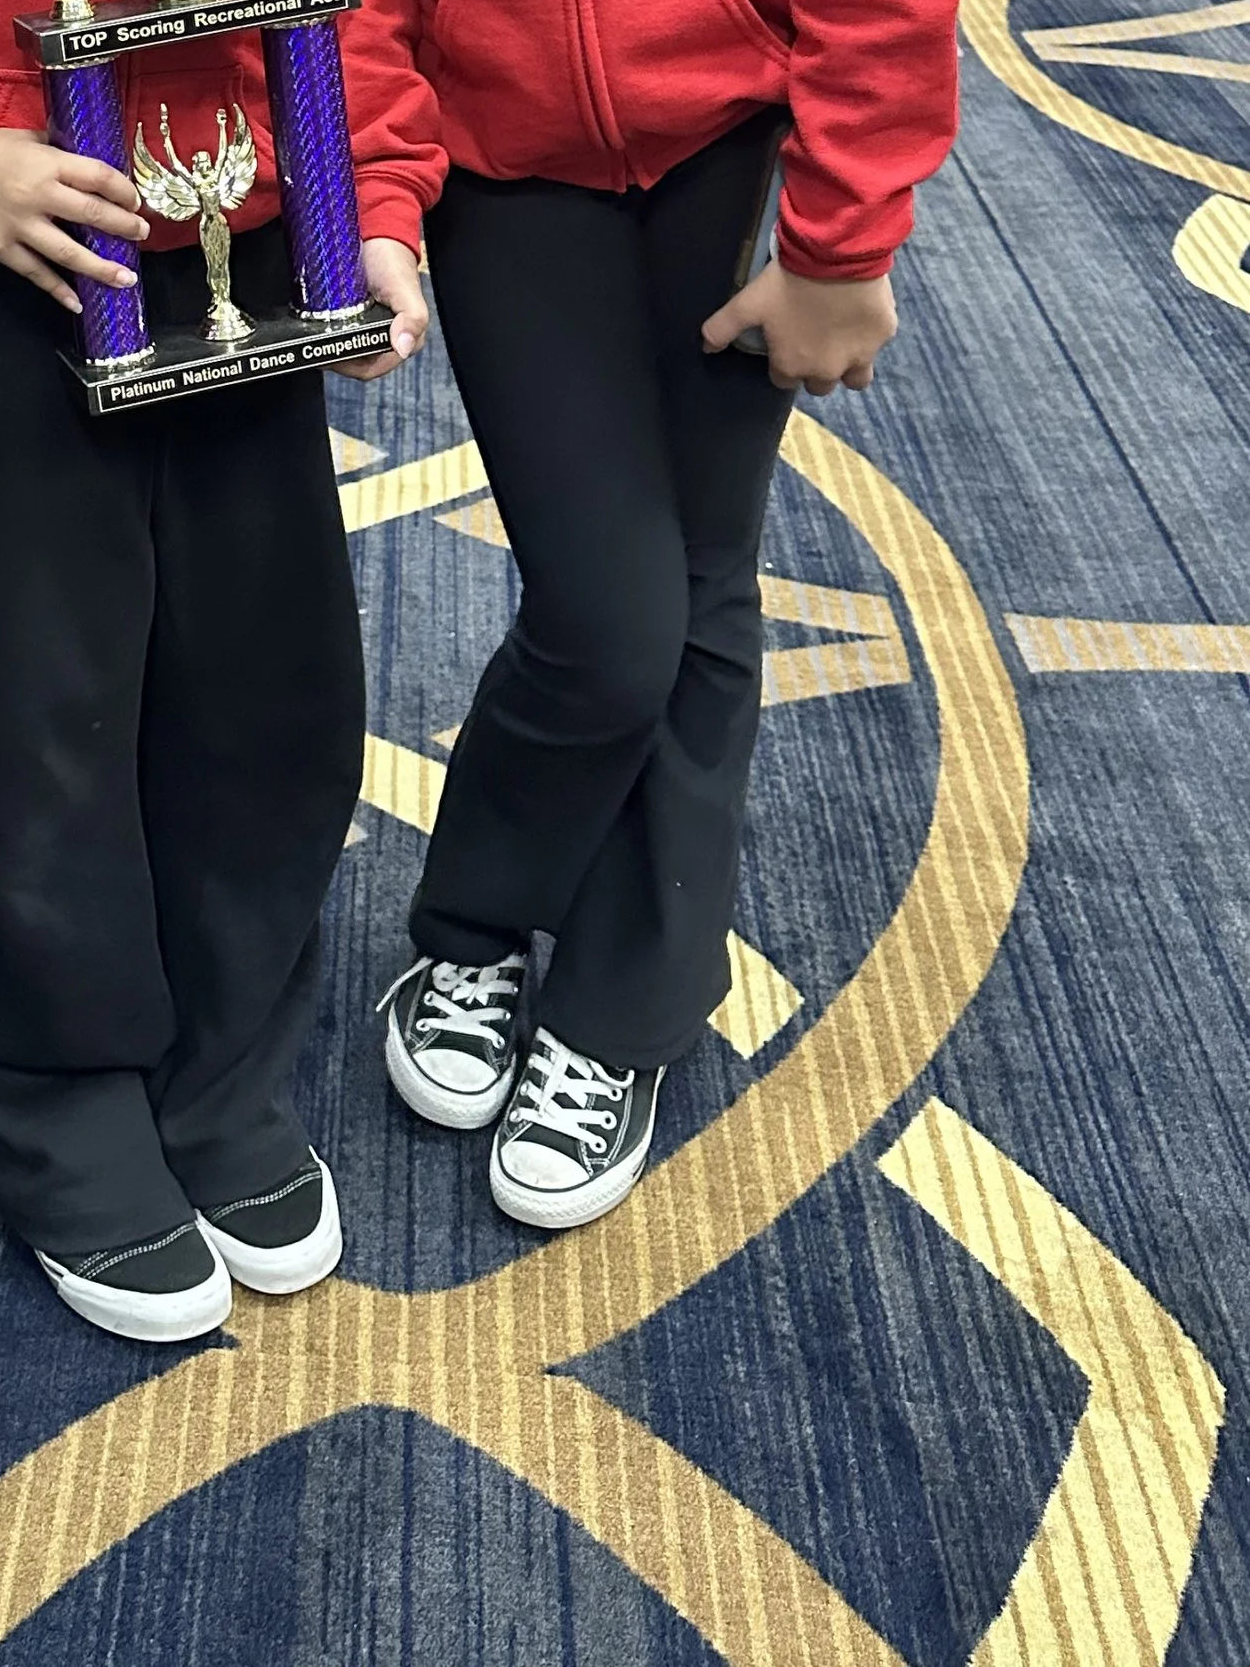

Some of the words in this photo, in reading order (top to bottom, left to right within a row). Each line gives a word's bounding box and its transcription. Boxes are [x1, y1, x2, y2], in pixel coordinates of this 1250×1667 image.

[69, 31, 108, 51] TOP
[117, 19, 185, 42] Scoring
[110, 377, 176, 402] Platinum
[183, 360, 242, 386] National
[249, 351, 295, 372] Dance
[302, 329, 389, 360] Competition
